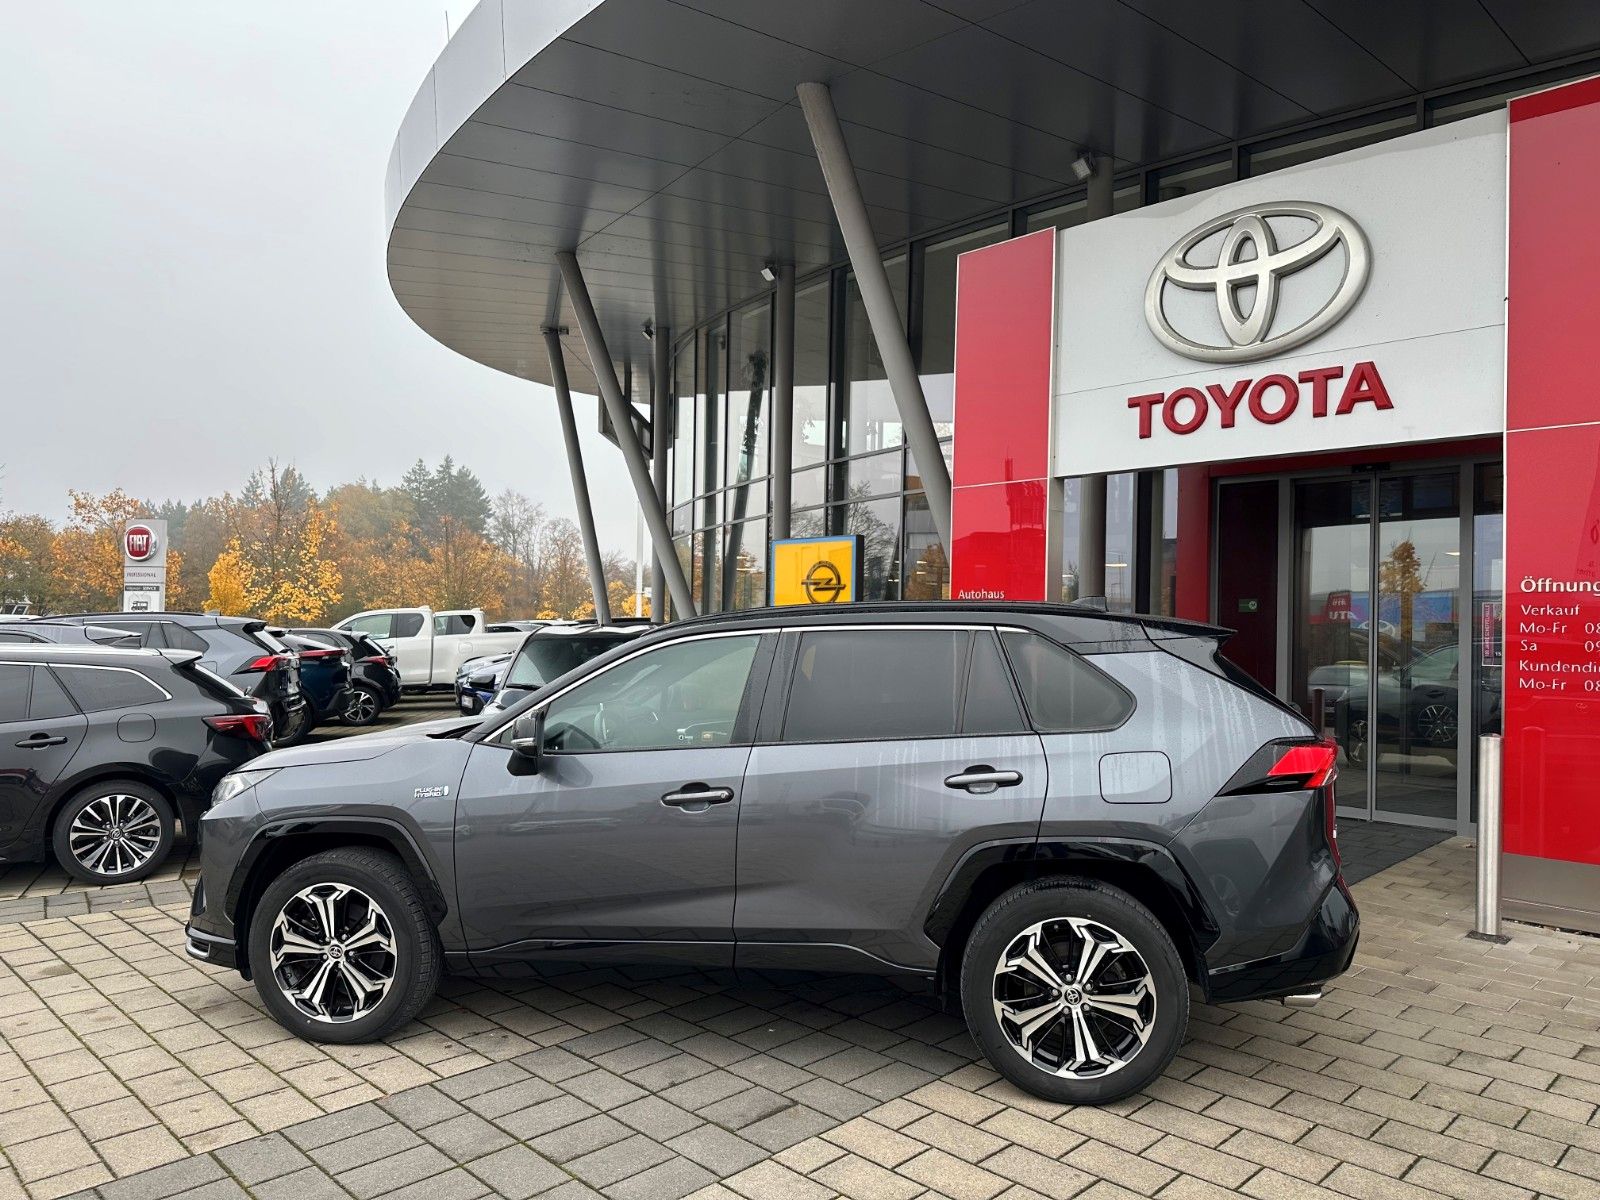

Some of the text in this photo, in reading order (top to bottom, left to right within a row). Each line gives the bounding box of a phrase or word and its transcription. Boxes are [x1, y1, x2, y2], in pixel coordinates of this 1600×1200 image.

[1127, 361, 1394, 439] TOYOTA
[129, 534, 149, 552] FIAT
[957, 588, 1005, 600] Autohaus
[1520, 604, 1580, 616] Verkauf
[1520, 621, 1567, 634] Mo-Fr
[1520, 639, 1537, 651] Sa
[1519, 660, 1600, 673] Kundendi
[1519, 677, 1567, 691] Mo-Fr
